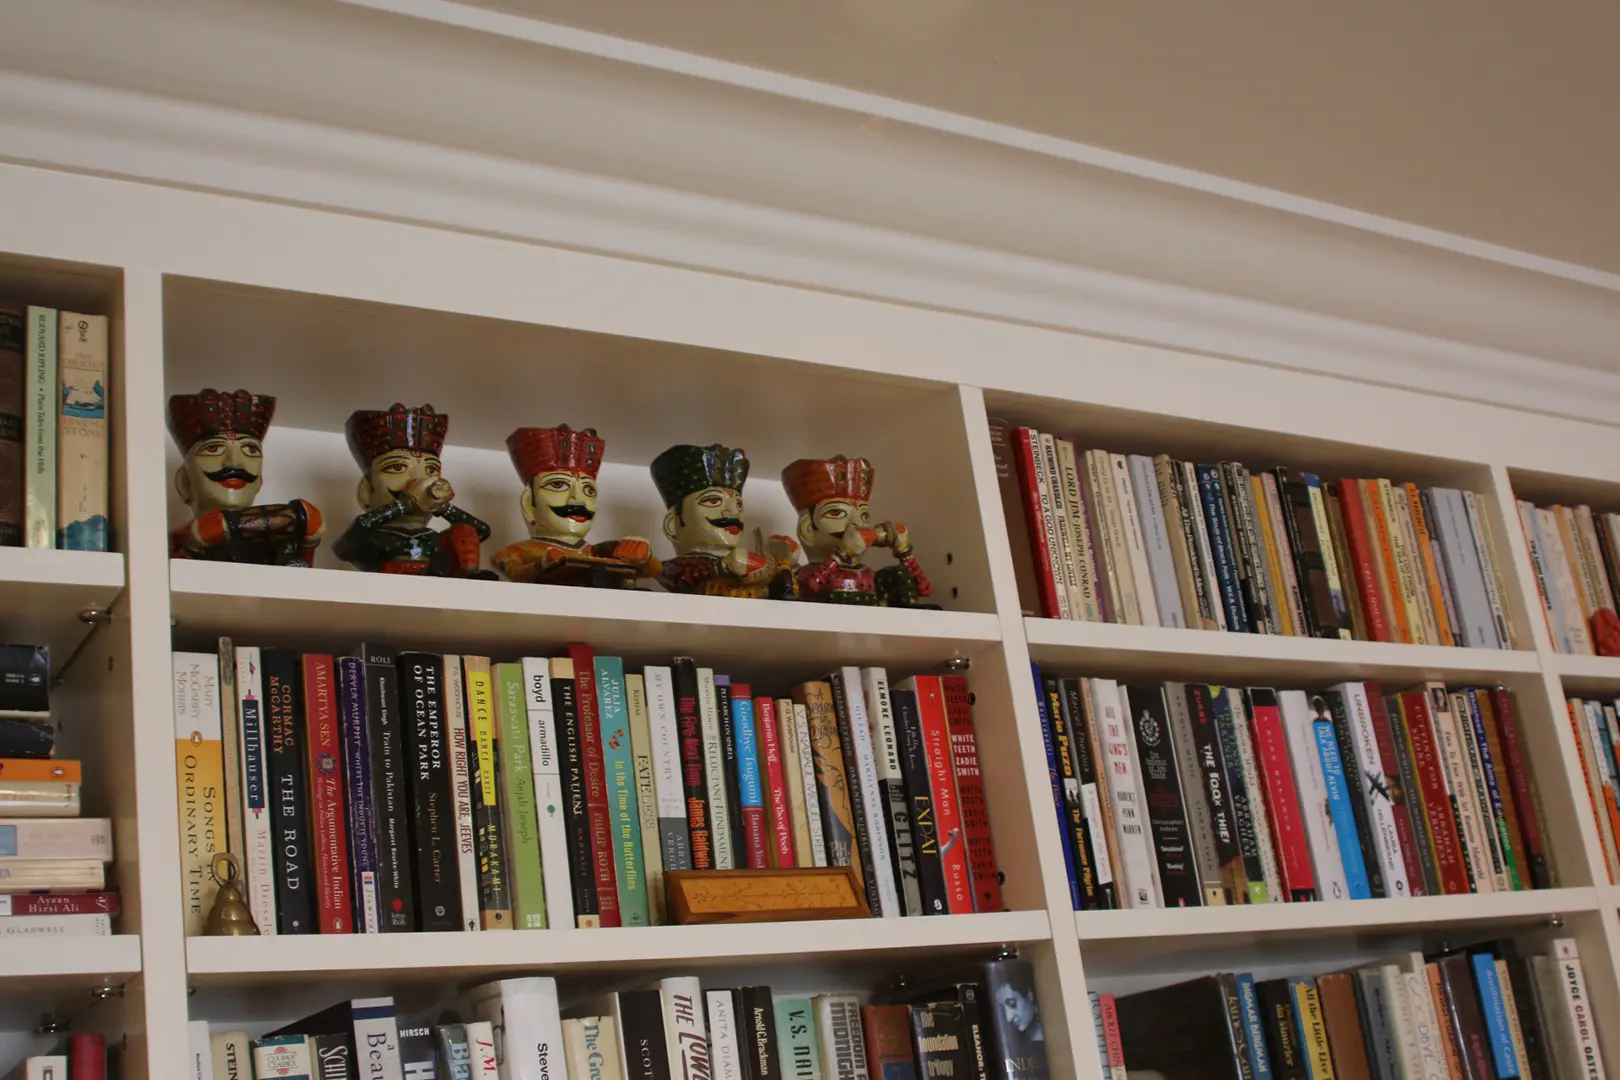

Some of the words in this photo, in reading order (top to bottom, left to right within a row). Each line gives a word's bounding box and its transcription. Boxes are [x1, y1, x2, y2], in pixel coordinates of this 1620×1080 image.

[1030, 434, 1044, 483] STEINBECK
[1041, 494, 1048, 506] TO
[1065, 467, 1077, 500] LORD
[1044, 514, 1054, 534] GOD
[1068, 501, 1079, 520] JIM
[1048, 537, 1063, 584] UNKNOWN
[1074, 523, 1084, 556] JOSEPH
[1079, 560, 1091, 598] CONRAD
[414, 664, 422, 682] OF
[426, 666, 436, 694] THE
[533, 674, 546, 704] boyd
[580, 670, 590, 688] The
[176, 671, 187, 716] MORRIS
[204, 676, 214, 708] MARY
[315, 662, 328, 725] AMARTYA
[475, 681, 487, 722] DANCE
[562, 685, 570, 707] THE
[600, 669, 612, 720] ALVAREZ
[610, 679, 620, 714] JULIA
[679, 696, 696, 713] The
[270, 676, 284, 754] McCARTHY
[282, 685, 295, 747] CORMAC
[415, 684, 426, 738] OCEAN
[506, 681, 520, 740] Saraswati
[580, 693, 594, 746] Professor
[680, 714, 698, 735] Fire
[740, 702, 755, 750] Goodbye
[762, 703, 774, 744] Benjamin
[834, 677, 846, 720] WILLIAM
[842, 722, 851, 756] STYRON
[877, 680, 889, 720] ELMORE
[883, 724, 896, 770] LEONARD
[1469, 691, 1482, 738] Whitehead
[319, 728, 331, 747] SEN
[428, 698, 441, 769] EMPEROR
[454, 727, 464, 748] HOW
[538, 719, 550, 767] armadillo
[566, 712, 578, 762] ENGLISH
[951, 734, 975, 744] WHITE
[1050, 692, 1064, 733] Mario
[1057, 736, 1072, 776] Puzo
[1068, 690, 1082, 728] Marcel
[1076, 732, 1090, 774] Theroux
[1108, 724, 1119, 737] THE
[1354, 694, 1376, 765] UNBROKEN
[1410, 727, 1426, 767] STONE
[1414, 705, 1430, 758] CUTTING
[1430, 764, 1438, 790] FOR
[244, 708, 260, 802] Millhauser
[419, 744, 430, 780] PARK
[454, 750, 466, 778] RIGHT
[479, 731, 488, 765] DANCE
[511, 744, 524, 773] Park
[588, 748, 596, 760] of
[616, 761, 624, 770] In
[682, 736, 700, 760] Next
[954, 744, 976, 754] TEETH
[956, 756, 978, 766] ZADIE
[1203, 744, 1216, 768] THE
[1318, 726, 1326, 743] TALK
[1322, 746, 1332, 772] ABOUT
[1328, 775, 1340, 800] KEVIN
[1323, 726, 1331, 737] WE
[1327, 741, 1338, 762] NEED
[1334, 764, 1341, 775] TO
[483, 770, 491, 796] DANCE
[588, 762, 600, 798] Desire
[616, 771, 625, 786] the
[684, 761, 702, 786] Time
[742, 758, 757, 804] Tsugumi
[930, 730, 947, 784] Straight
[940, 788, 950, 816] Man
[957, 766, 980, 776] SMITH
[1112, 762, 1128, 774] MEN
[1485, 763, 1494, 786] Aims
[184, 755, 198, 857] ORDINARY
[280, 774, 296, 817] THE
[326, 778, 338, 798] The
[386, 772, 394, 812] Pakistan
[458, 780, 468, 798] YOU
[515, 778, 528, 816] Anjali
[570, 767, 583, 816] PATIENT
[618, 787, 628, 810] Time
[1209, 772, 1222, 808] BOOK
[1491, 789, 1500, 798] of
[203, 786, 216, 853] SONGS
[428, 792, 438, 832] Stephen
[458, 798, 470, 816] ARE,
[620, 812, 628, 822] of
[688, 796, 706, 828] James
[850, 766, 862, 808] DARKNESS
[858, 815, 869, 852] VISIBLE
[914, 796, 937, 854] EXPAT
[1070, 808, 1079, 824] The
[326, 803, 340, 873] Argumentative
[431, 834, 439, 846] L.
[460, 818, 473, 854] JEEVES
[516, 818, 528, 845] Joseph
[594, 812, 605, 848] PHILIP
[621, 824, 630, 838] the
[873, 812, 886, 861] ROBINSON
[1216, 812, 1231, 844] THIEF
[1234, 795, 1250, 858] VERGHESE
[1240, 796, 1257, 857] ABRAHAM
[1376, 808, 1394, 872] HILLENBRAND
[1386, 824, 1398, 854] LAURA
[1427, 802, 1446, 866] VERGHESE
[1437, 806, 1455, 864] ABRAHAM
[1494, 802, 1510, 850] Education
[284, 829, 300, 890] ROAD
[488, 823, 501, 892] MURAKAMI
[692, 830, 711, 868] Baldwin
[894, 811, 916, 879] GLITZ
[1072, 828, 1087, 865] Fortunate
[432, 850, 441, 884] Carter
[599, 850, 610, 881] ROTH
[623, 839, 636, 891] Butterflies
[952, 864, 962, 901] Russo
[1081, 866, 1094, 897] Pilgrim
[28, 902, 59, 912] Hirsi
[36, 895, 70, 904] Ayaan
[62, 902, 80, 912] Ali
[190, 866, 200, 914] TIME
[332, 876, 341, 909] Indian
[6, 925, 66, 934] GLADWELL
[673, 994, 695, 1026] THE
[1242, 982, 1258, 1021] INGMAR
[1304, 986, 1314, 1002] All
[1565, 964, 1582, 1000] JOYCE
[1575, 1004, 1590, 1043] CAROL
[921, 1010, 935, 1028] the
[1094, 999, 1108, 1052] RALPH
[1306, 1004, 1316, 1022] the
[1486, 970, 1504, 1032] Annihilation
[1500, 1033, 1508, 1044] of
[1504, 1046, 1516, 1074] Caste
[400, 1027, 430, 1038] HIRSCH
[753, 1007, 764, 1034] Arnold
[759, 1039, 768, 1076] Brackman
[847, 1002, 865, 1069] FREEDOM
[918, 1034, 959, 1052] foundation
[1249, 1022, 1268, 1072] BERGMAN
[1311, 1024, 1323, 1050] Little
[928, 1058, 954, 1077] trilogy
[1317, 1055, 1328, 1076] Live
